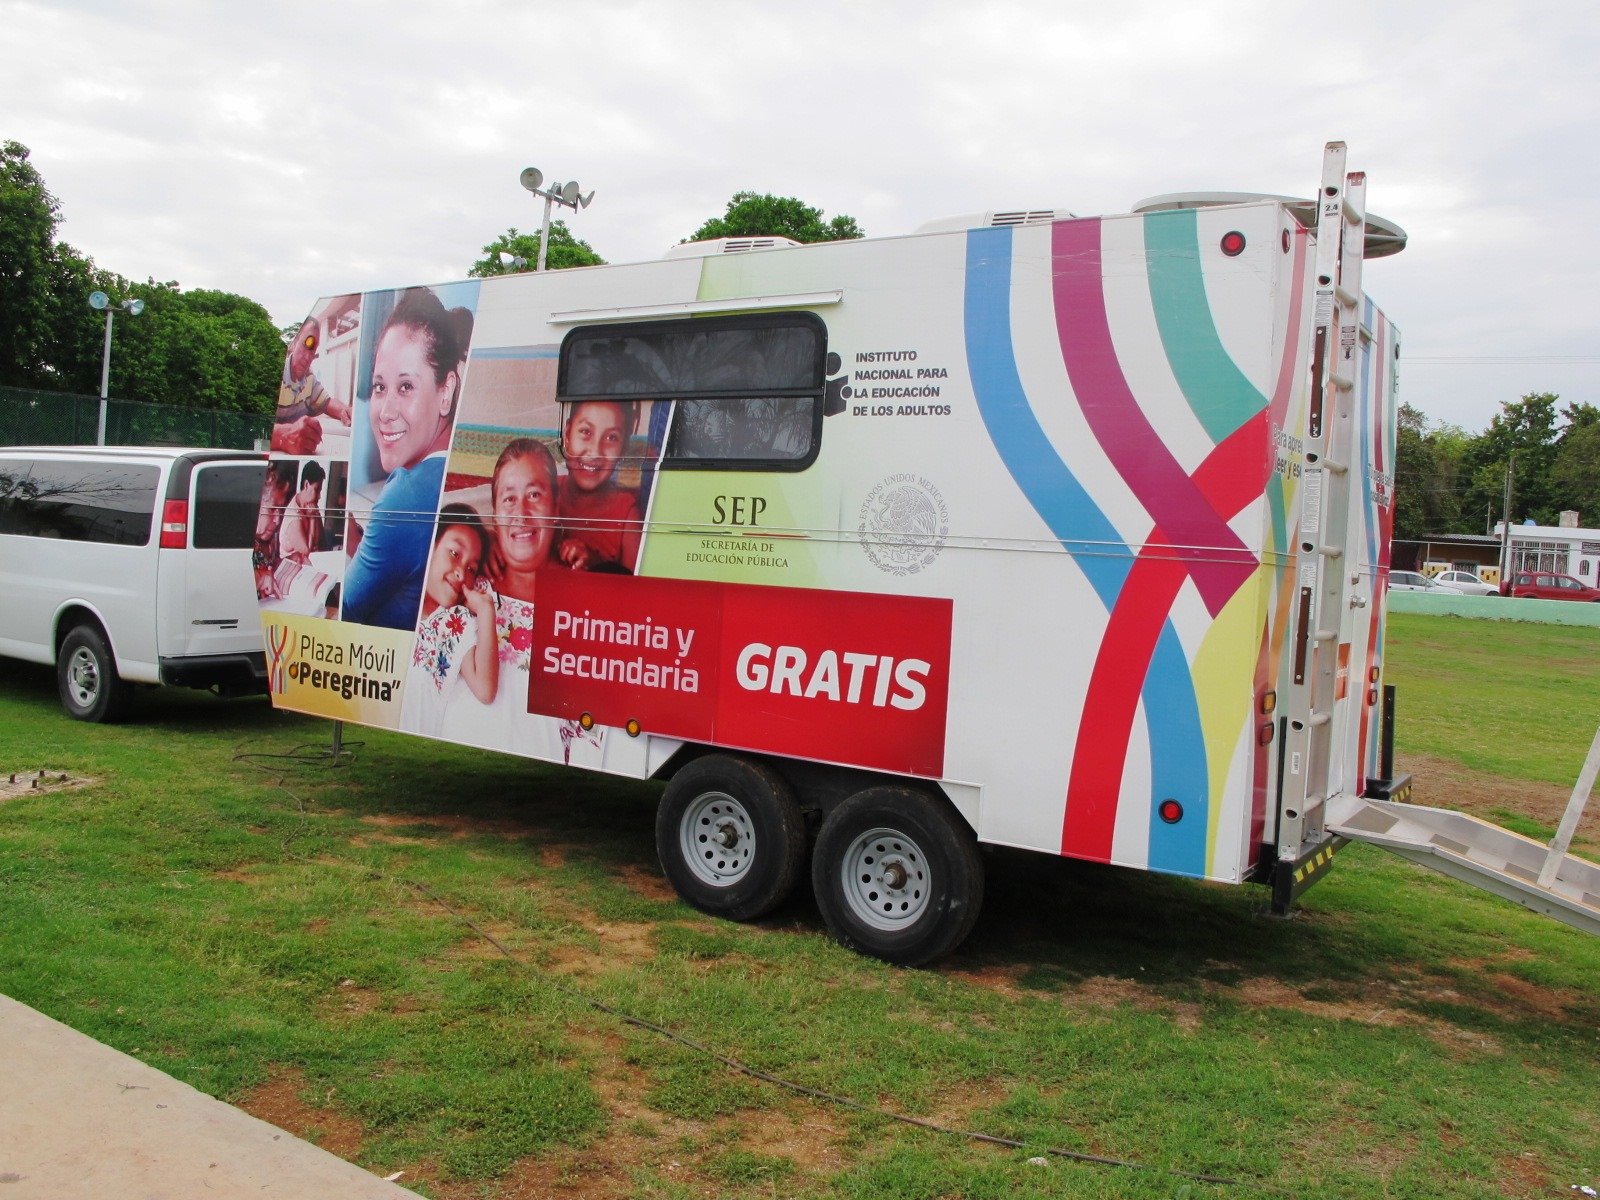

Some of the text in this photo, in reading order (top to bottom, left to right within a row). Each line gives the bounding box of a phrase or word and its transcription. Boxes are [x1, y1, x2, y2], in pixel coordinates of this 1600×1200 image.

[855, 350, 918, 363] INSTITUTO
[854, 367, 949, 381] NACIONAL PARA
[853, 385, 941, 399] LA EDUCACIÓN
[852, 404, 952, 417] DE LOS ADULTOS
[859, 473, 949, 524] ESTADOS UNIDOS MEXICANOS
[712, 495, 767, 526] SEP
[700, 540, 775, 553] SECRETARÍA DE
[686, 552, 789, 568] EDUCACIÓN PÚBLICA
[553, 610, 695, 657] Primaria y
[300, 634, 395, 674] Plaza Móvil
[543, 646, 699, 693] Secundaria
[736, 642, 931, 711] GRATIS
